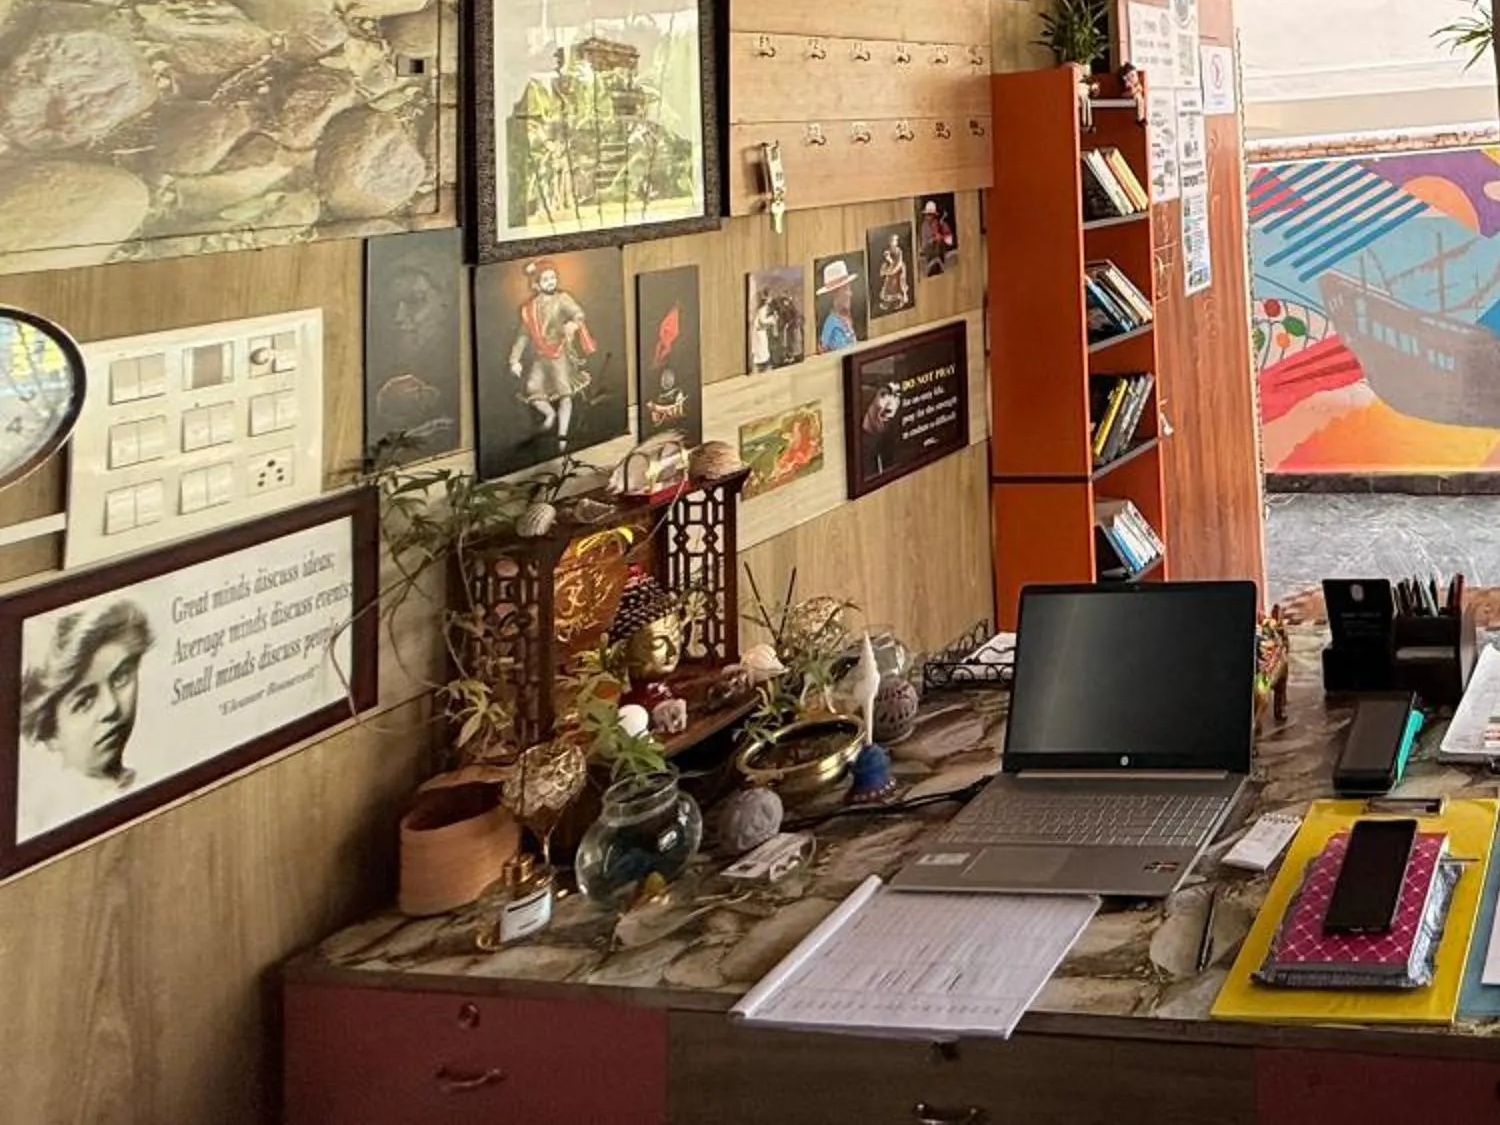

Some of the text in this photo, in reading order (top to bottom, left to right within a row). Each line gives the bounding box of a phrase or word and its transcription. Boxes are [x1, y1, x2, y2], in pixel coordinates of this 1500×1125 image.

[172, 590, 209, 623] Great
[212, 574, 251, 609] minds
[254, 565, 299, 594] discuss
[171, 629, 226, 665] Average
[229, 606, 268, 643] minds
[270, 595, 314, 627] discuss
[171, 665, 214, 705] Small
[215, 650, 256, 688] minds
[258, 638, 302, 671] discuss
